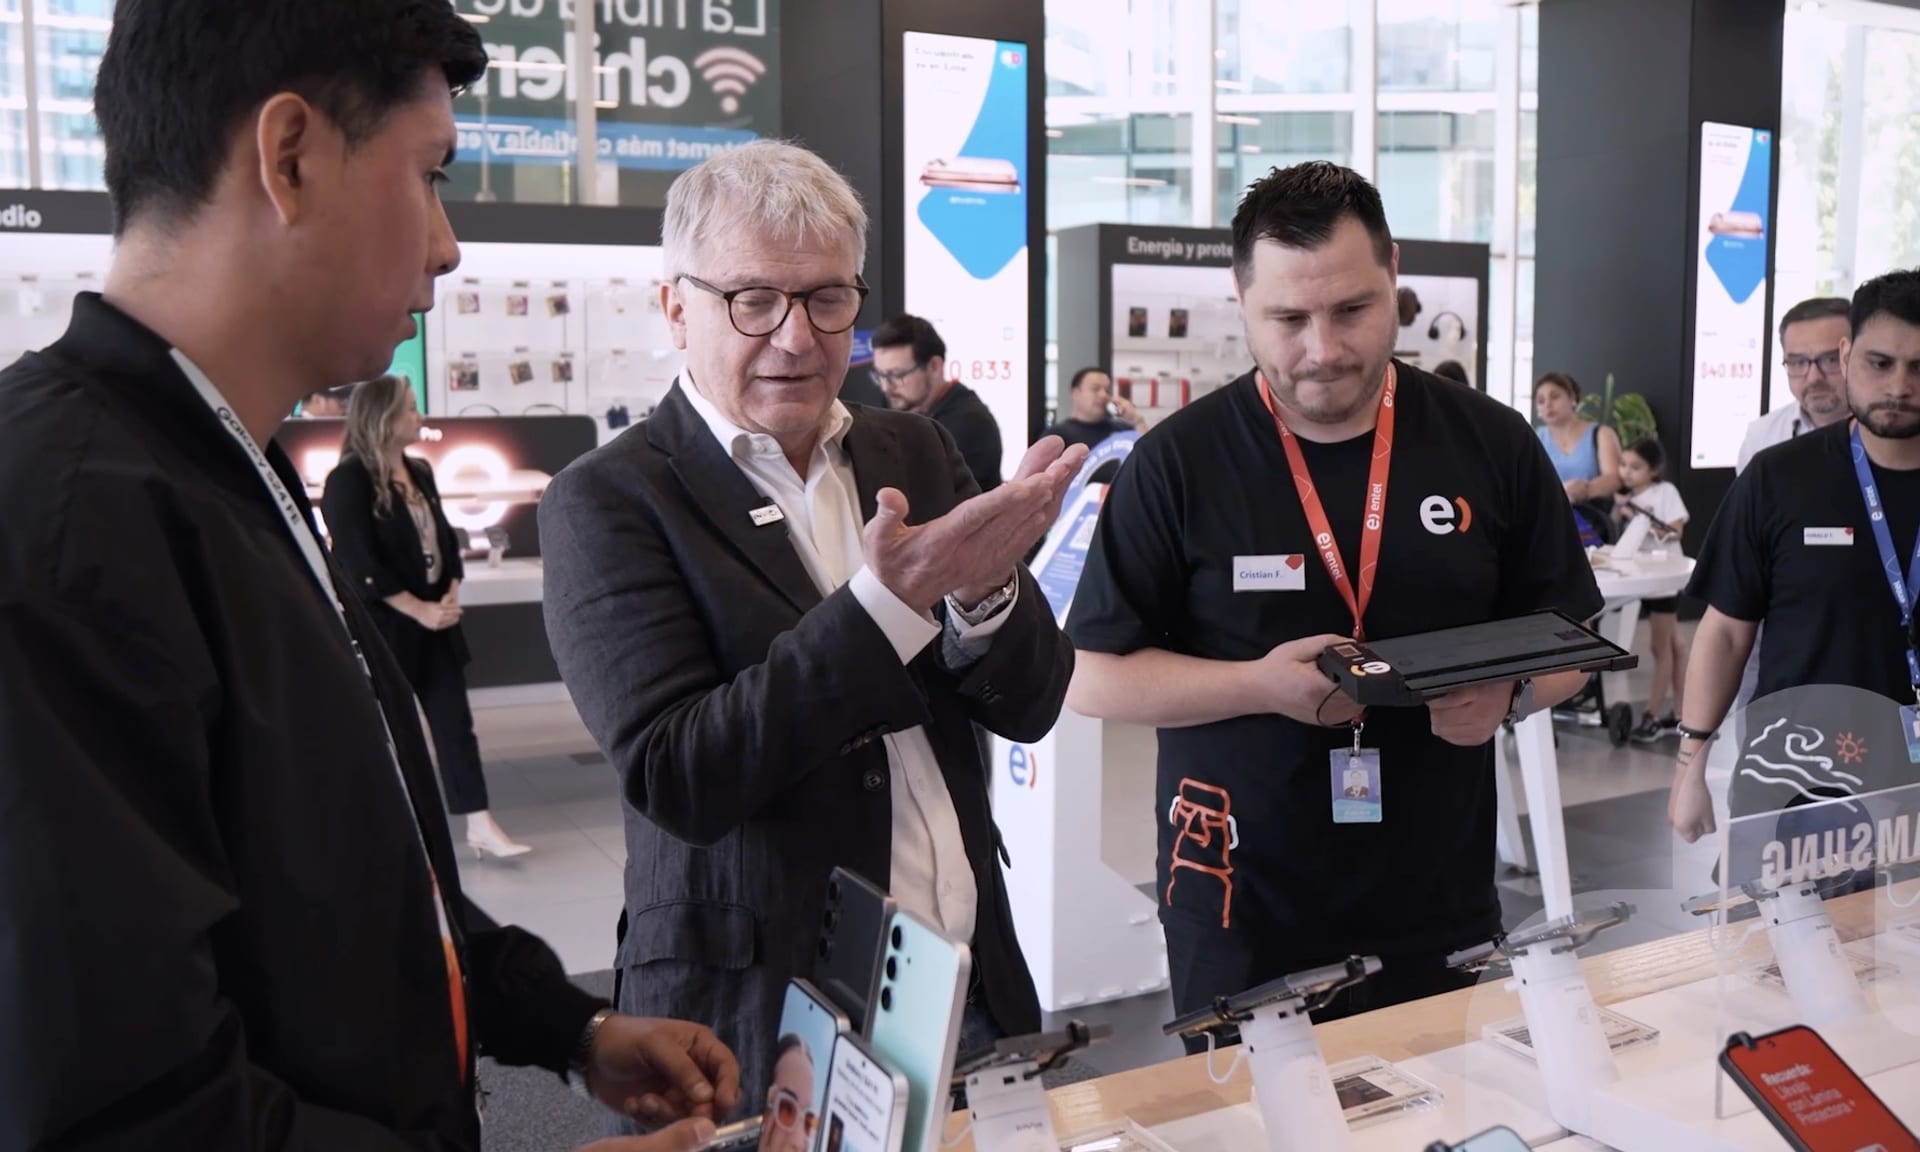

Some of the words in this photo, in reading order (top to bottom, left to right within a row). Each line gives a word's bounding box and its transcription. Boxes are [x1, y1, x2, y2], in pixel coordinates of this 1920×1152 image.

[0, 203, 42, 229] dio
[1185, 242, 1196, 260] y
[217, 406, 267, 468] Galaxy
[286, 503, 300, 526] FE
[1370, 483, 1383, 512] entel
[1239, 568, 1273, 580] Cristian
[1324, 551, 1343, 580] entel
